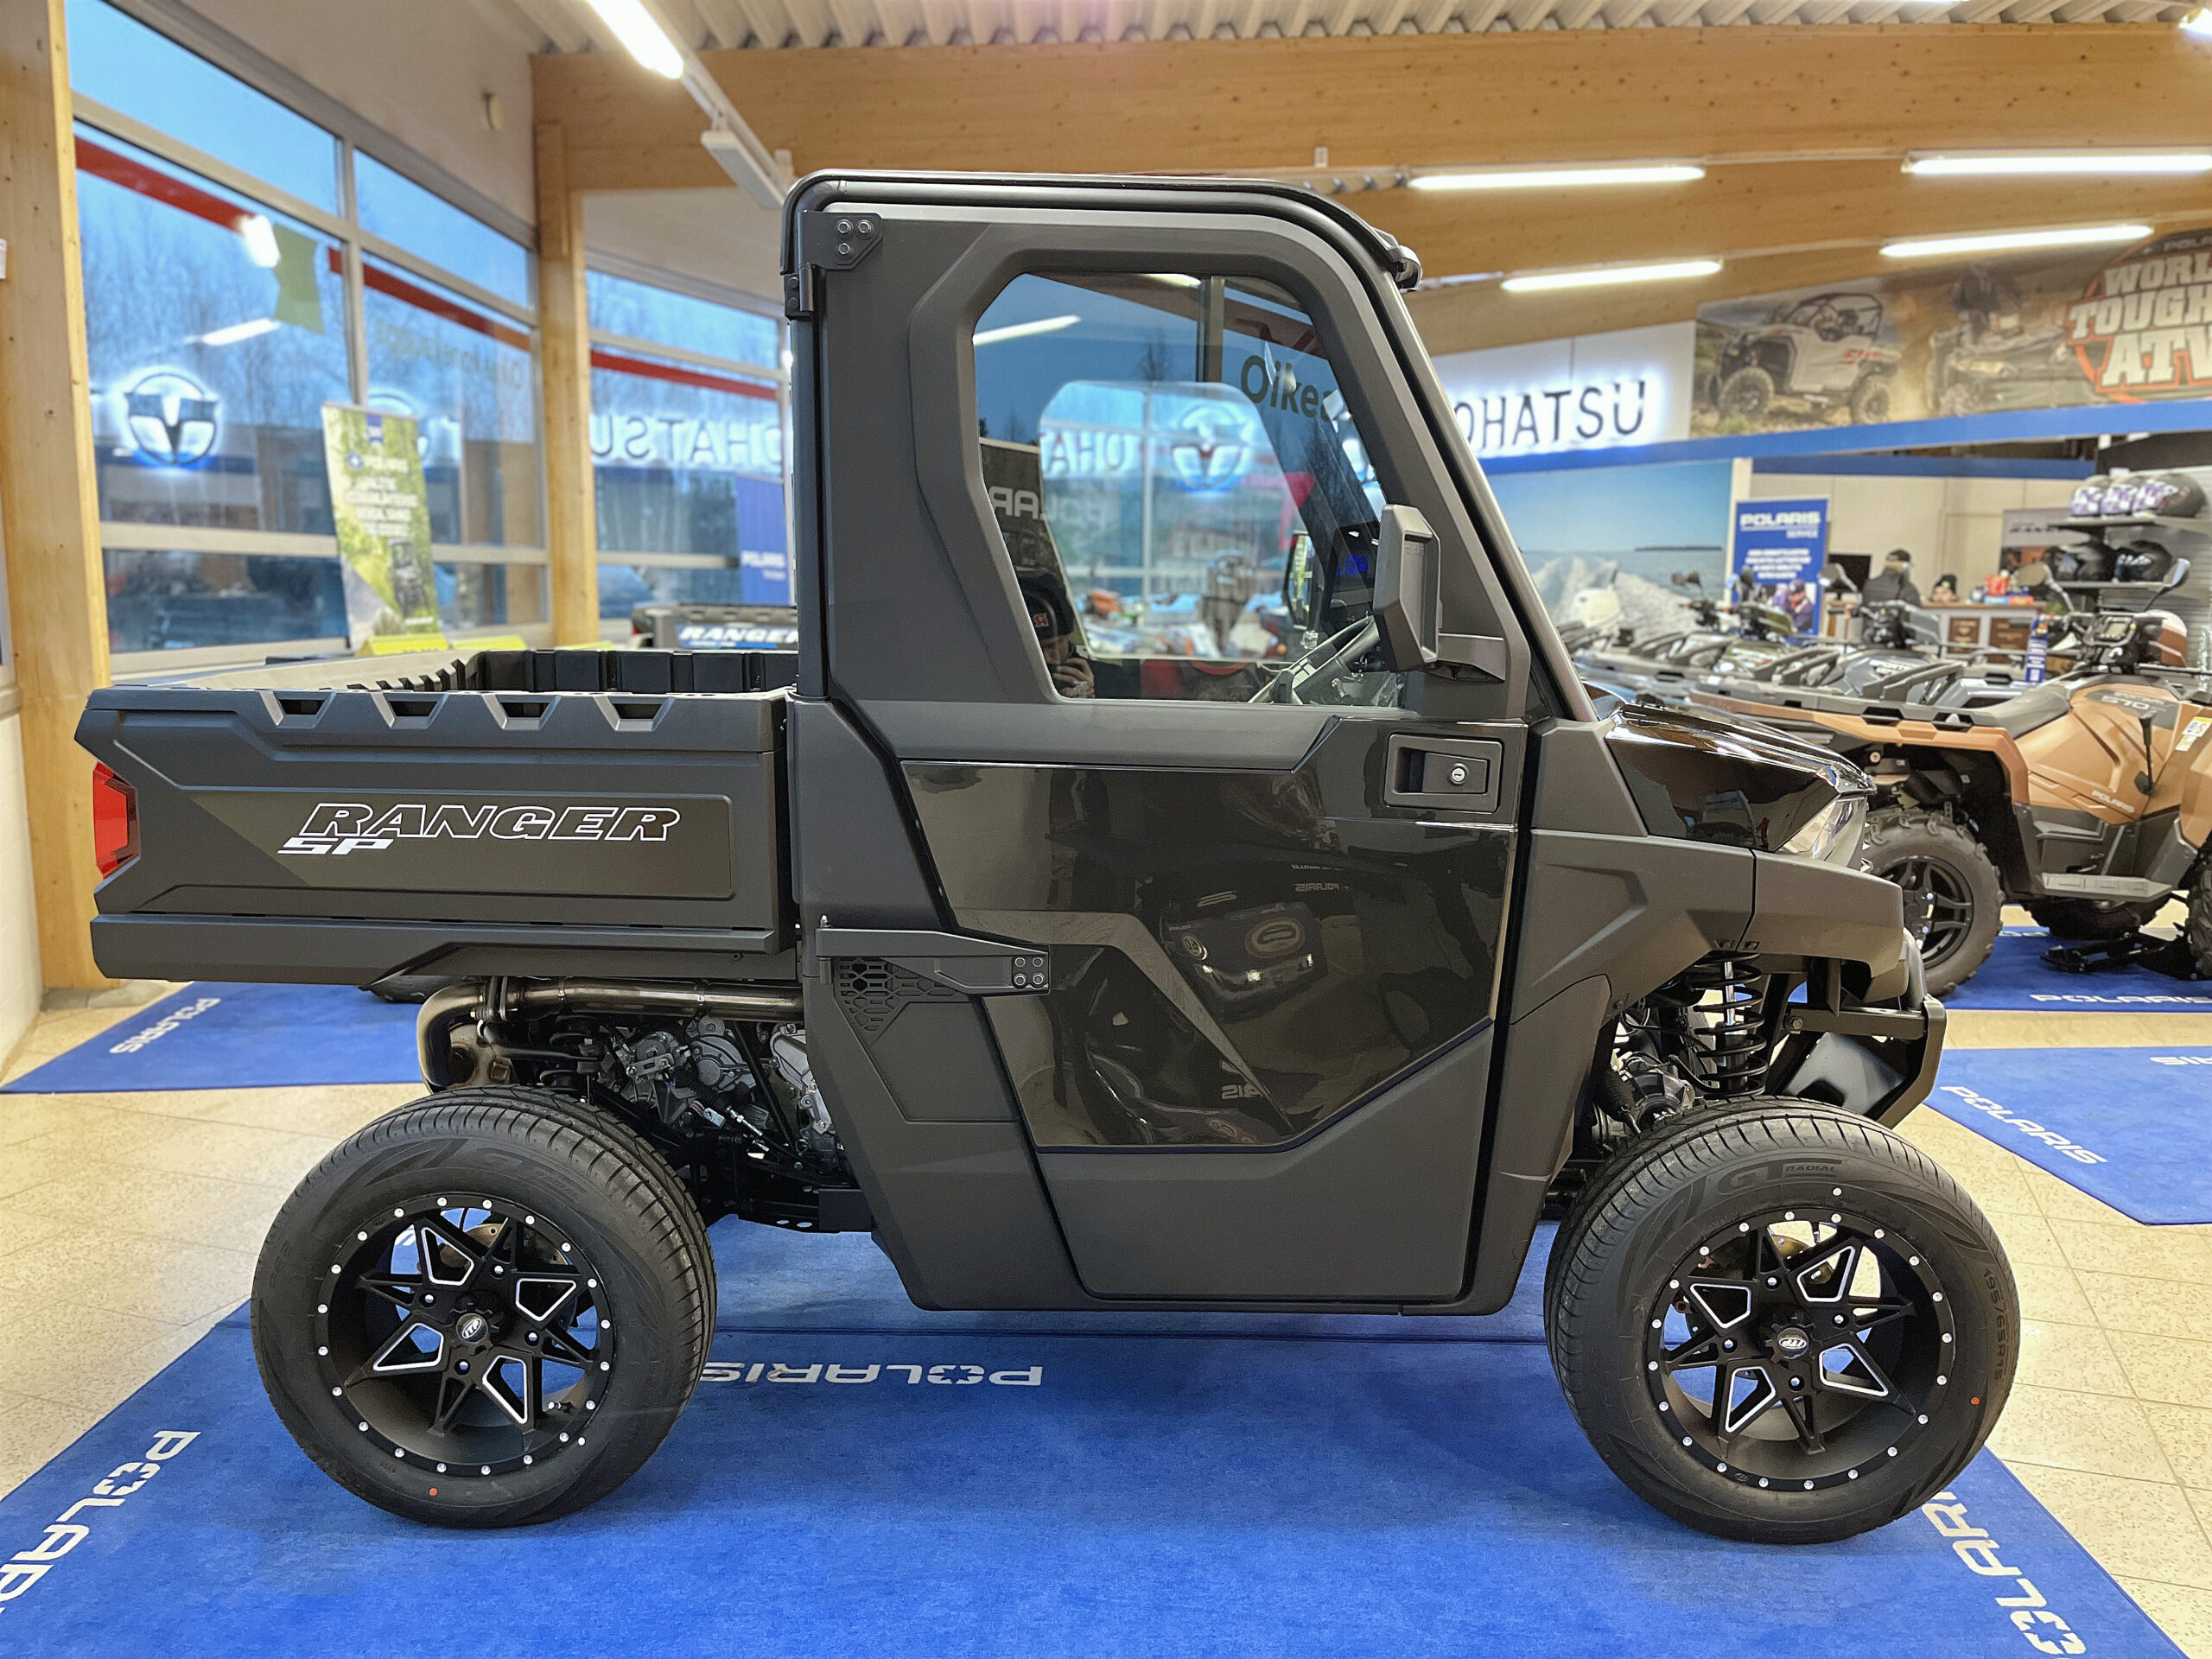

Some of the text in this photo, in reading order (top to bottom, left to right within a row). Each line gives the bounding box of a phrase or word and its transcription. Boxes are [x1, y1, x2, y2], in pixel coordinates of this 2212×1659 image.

[1739, 511, 1821, 526] POLARIS
[2101, 695, 2150, 711] 570
[2092, 790, 2134, 813] POLARIS
[300, 803, 680, 841] RANGER
[277, 836, 394, 855] SP
[109, 998, 221, 1053] POLARIS
[1939, 1086, 2109, 1164] POLARIS
[699, 1362, 1043, 1386] POLARIS
[0, 1431, 201, 1613] POLAR
